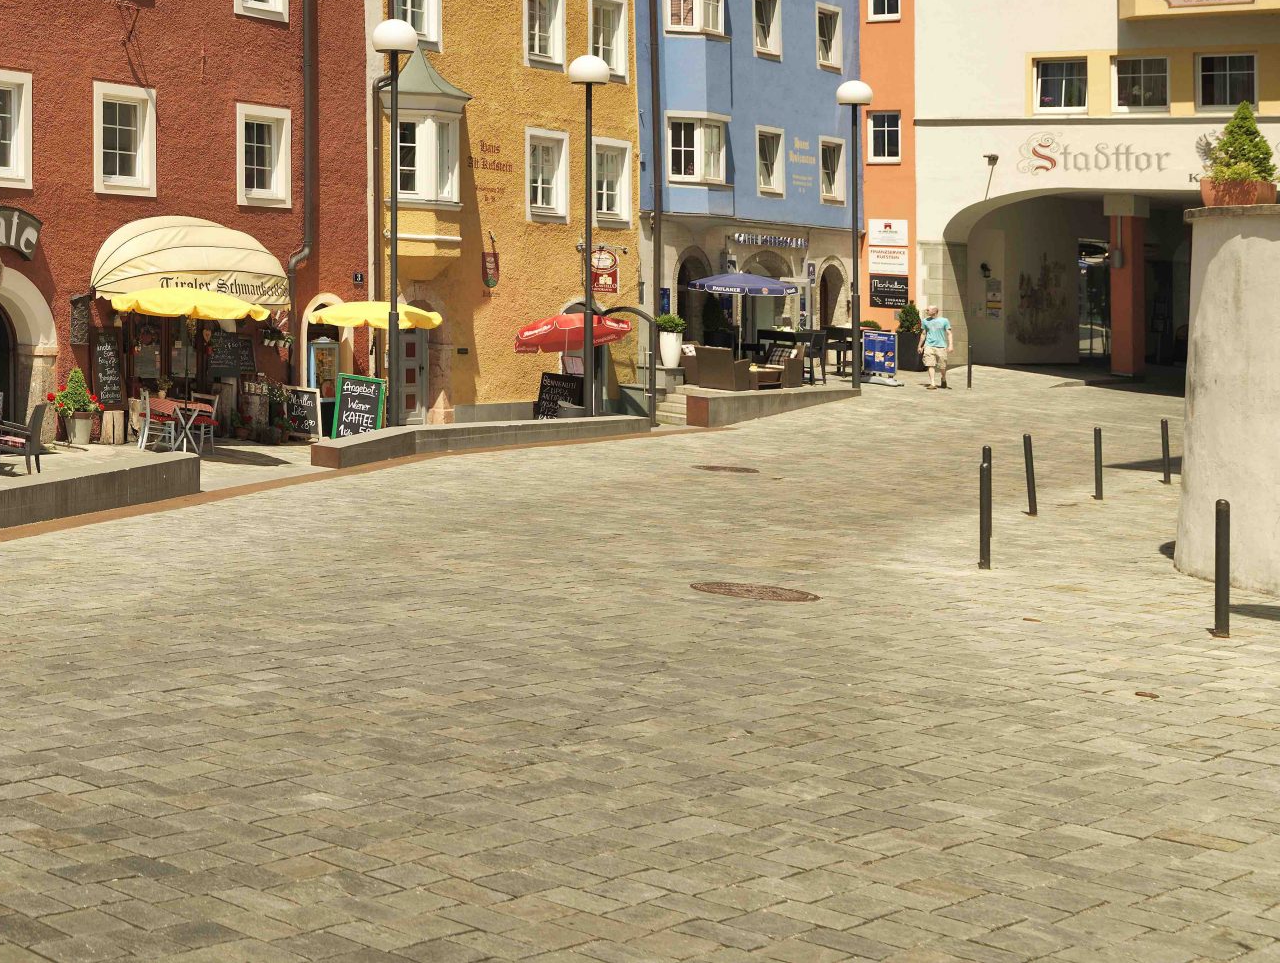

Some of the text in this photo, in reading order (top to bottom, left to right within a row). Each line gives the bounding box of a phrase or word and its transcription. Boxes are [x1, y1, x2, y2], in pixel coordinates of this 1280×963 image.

[1022, 134, 1171, 174] Stadttor
[712, 285, 741, 293] PAULANER
[342, 381, 378, 396] Angebot:
[342, 410, 375, 427] KAFFEE
